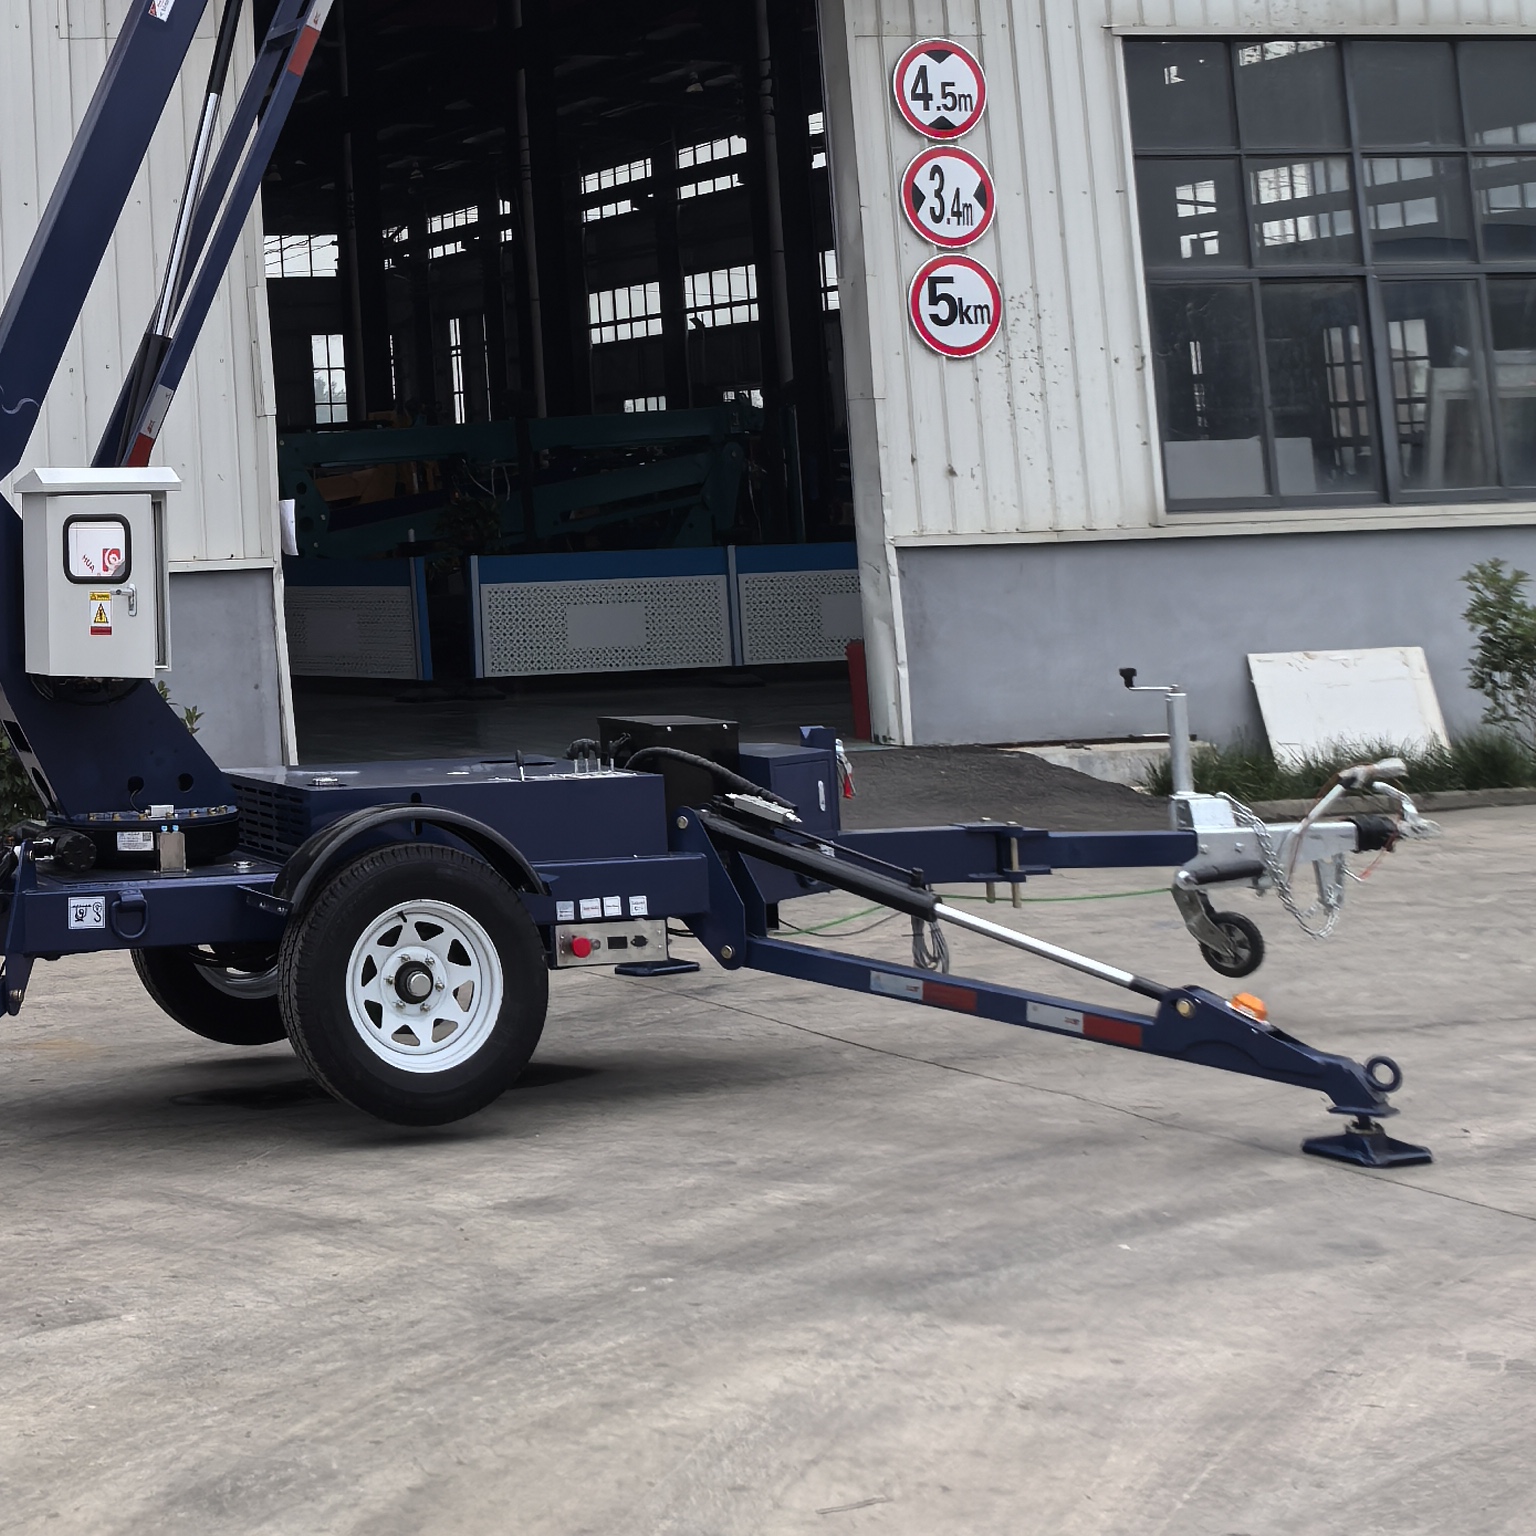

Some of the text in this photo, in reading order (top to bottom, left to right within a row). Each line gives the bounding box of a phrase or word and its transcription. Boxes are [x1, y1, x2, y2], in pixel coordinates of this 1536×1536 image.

[910, 65, 974, 112] 4.5m
[929, 164, 974, 226] 3.4m
[927, 276, 992, 326] 5km
